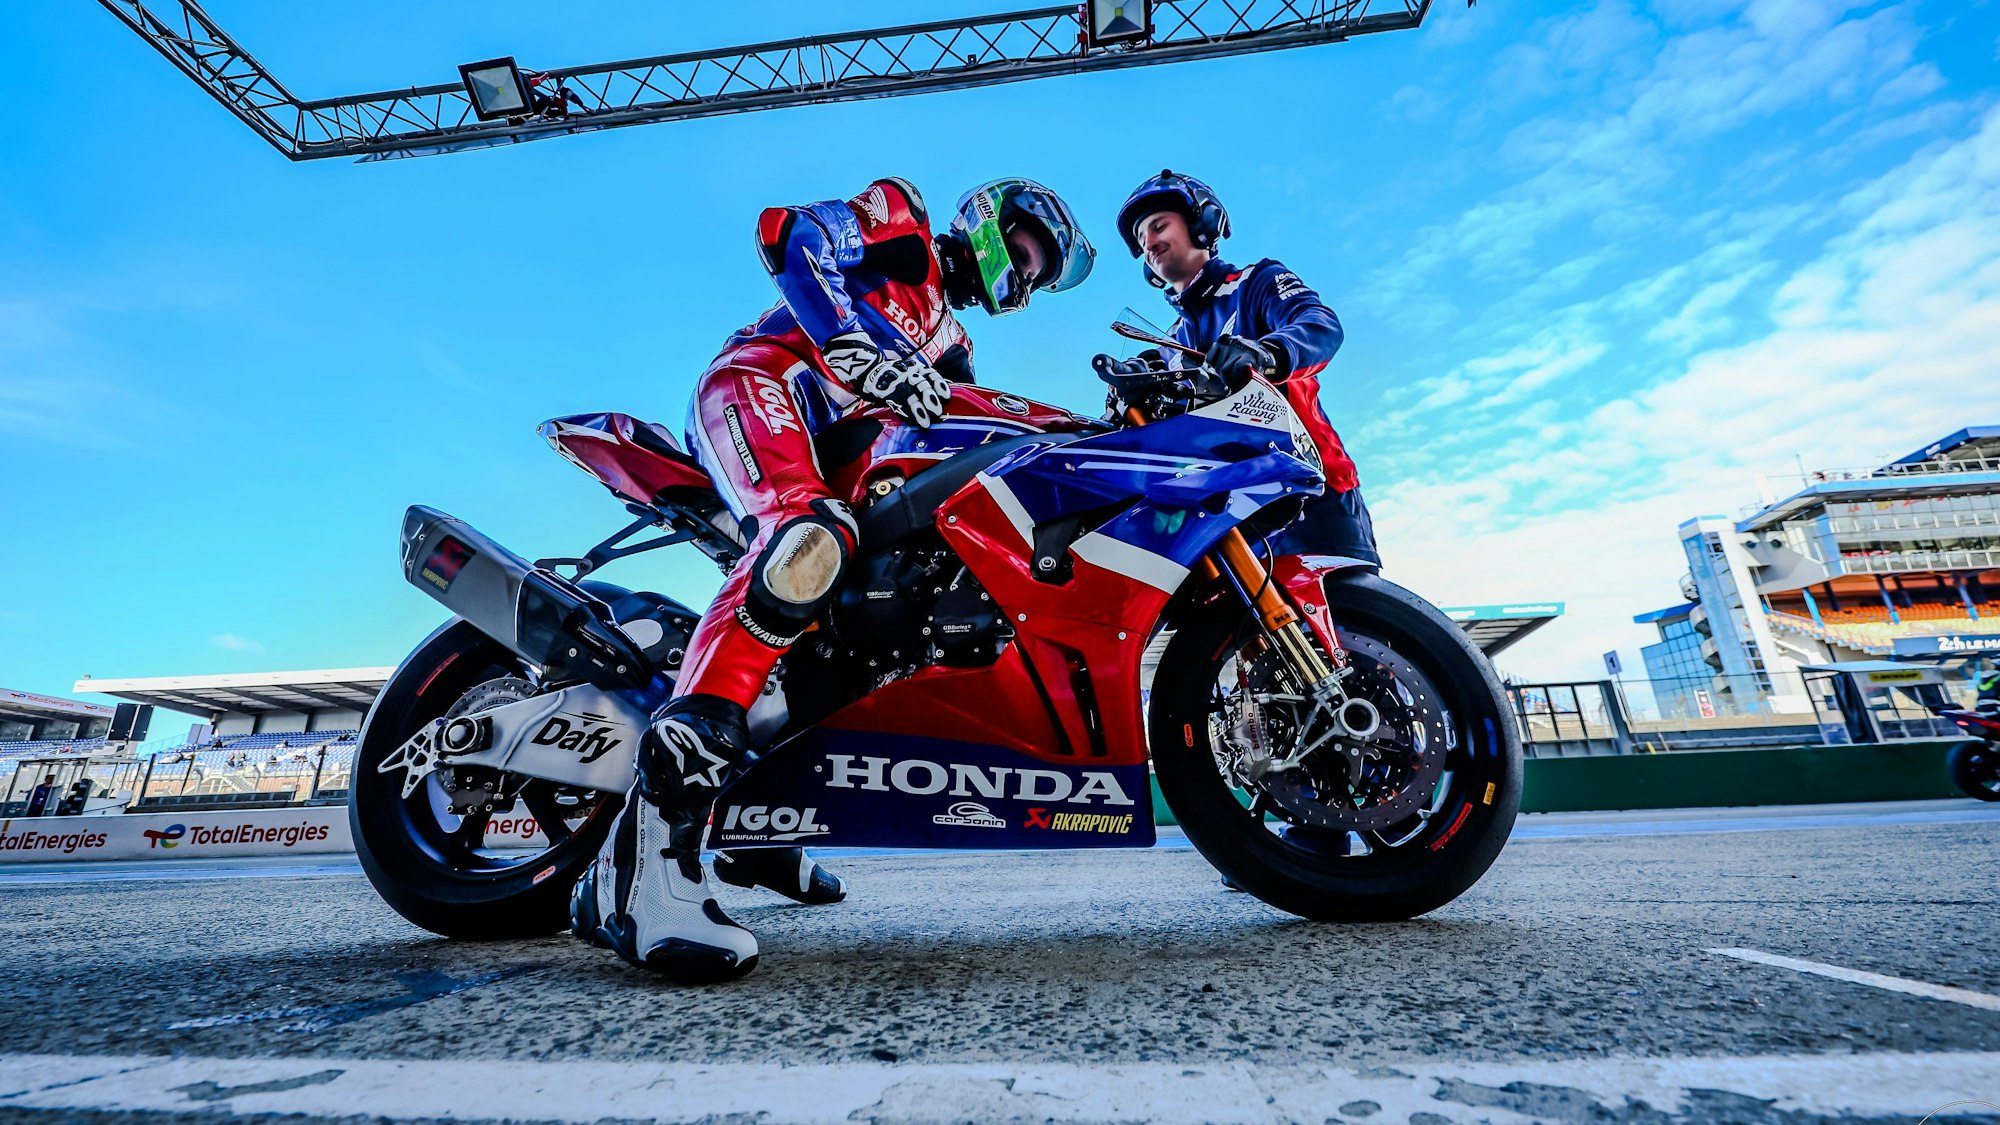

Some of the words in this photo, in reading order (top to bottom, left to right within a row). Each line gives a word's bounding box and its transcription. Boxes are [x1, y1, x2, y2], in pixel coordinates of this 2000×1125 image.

[851, 197, 878, 229] HONDA
[975, 191, 996, 219] NOLAN
[1230, 402, 1277, 425] Racing
[530, 716, 623, 764] Dafy
[1247, 712, 1260, 750] brembo
[825, 754, 1135, 806] HONDA
[190, 821, 329, 847] TotalEnergies
[935, 815, 1005, 827] carbonin
[1051, 812, 1133, 834] AKRAPOVIČ
